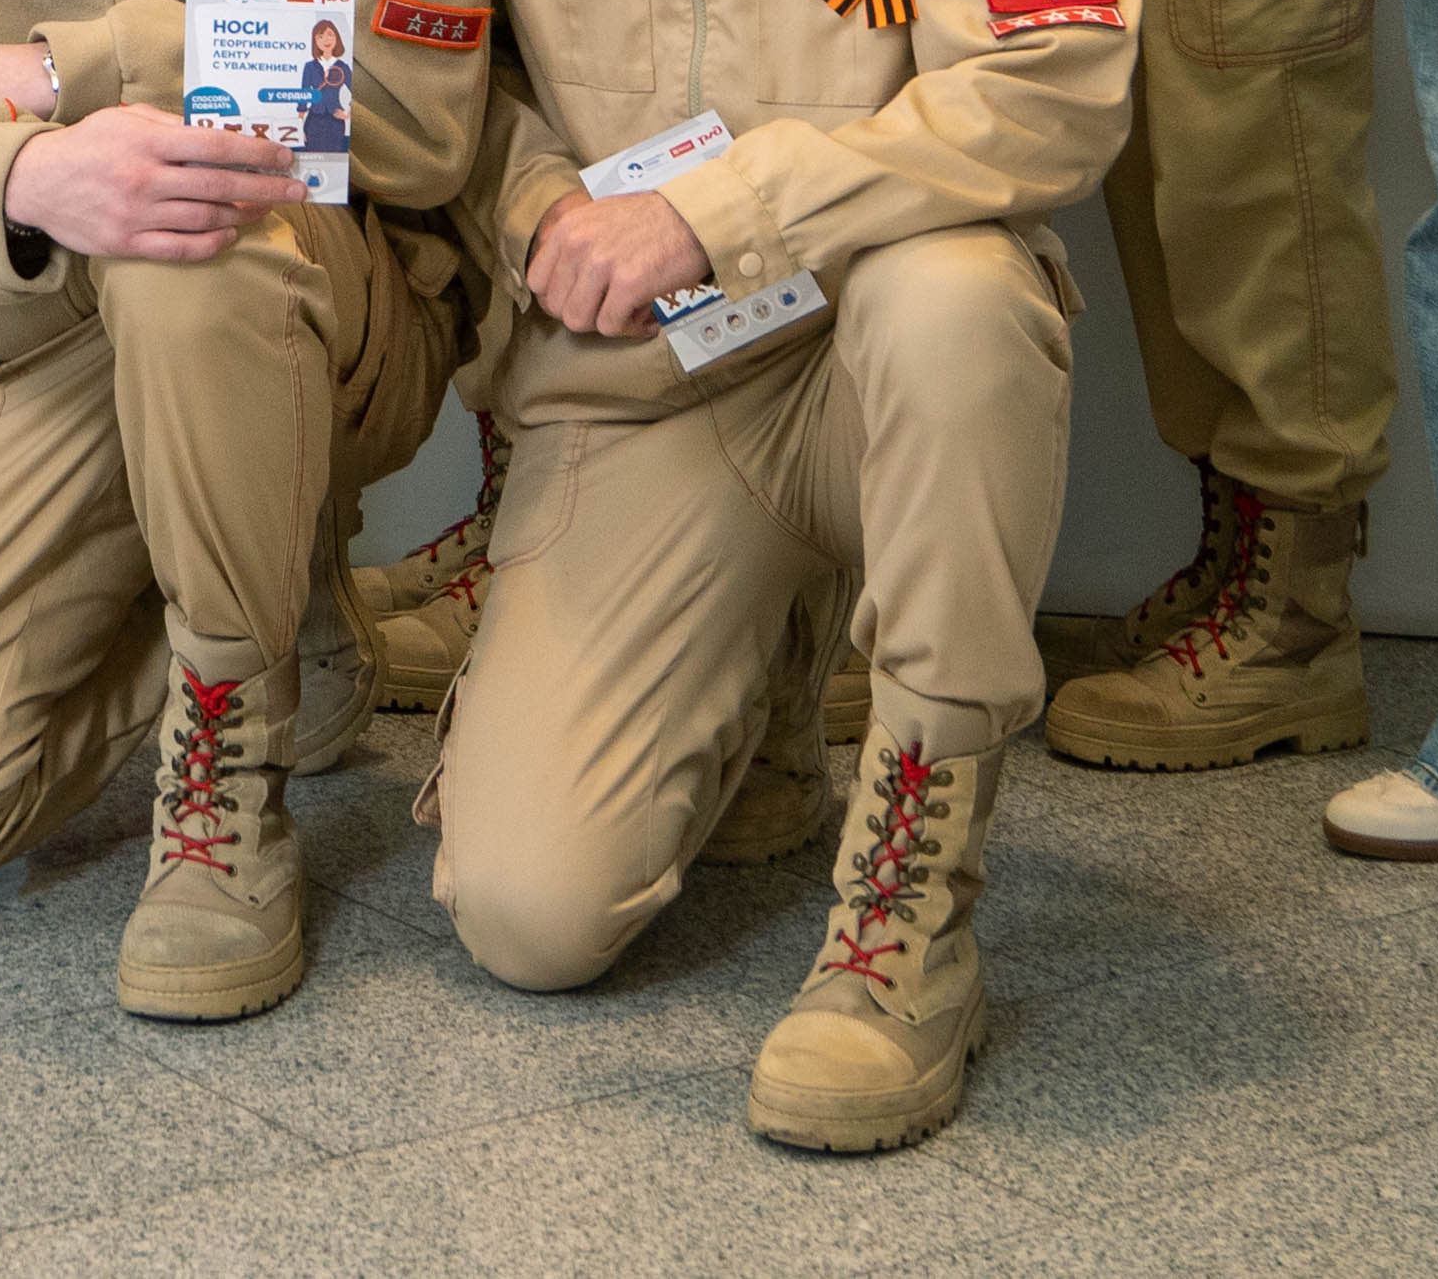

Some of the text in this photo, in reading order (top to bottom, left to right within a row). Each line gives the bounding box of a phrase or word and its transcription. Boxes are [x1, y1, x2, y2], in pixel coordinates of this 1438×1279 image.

[213, 18, 269, 35] НОСИ
[213, 39, 307, 51] ГЕОРГИЕВСКУЮ
[213, 50, 251, 60] ЛЕНТУ
[224, 62, 298, 73] УВАЖЕНИЕМ
[191, 95, 231, 103] СПОСОБЫ
[276, 92, 313, 101] сердца
